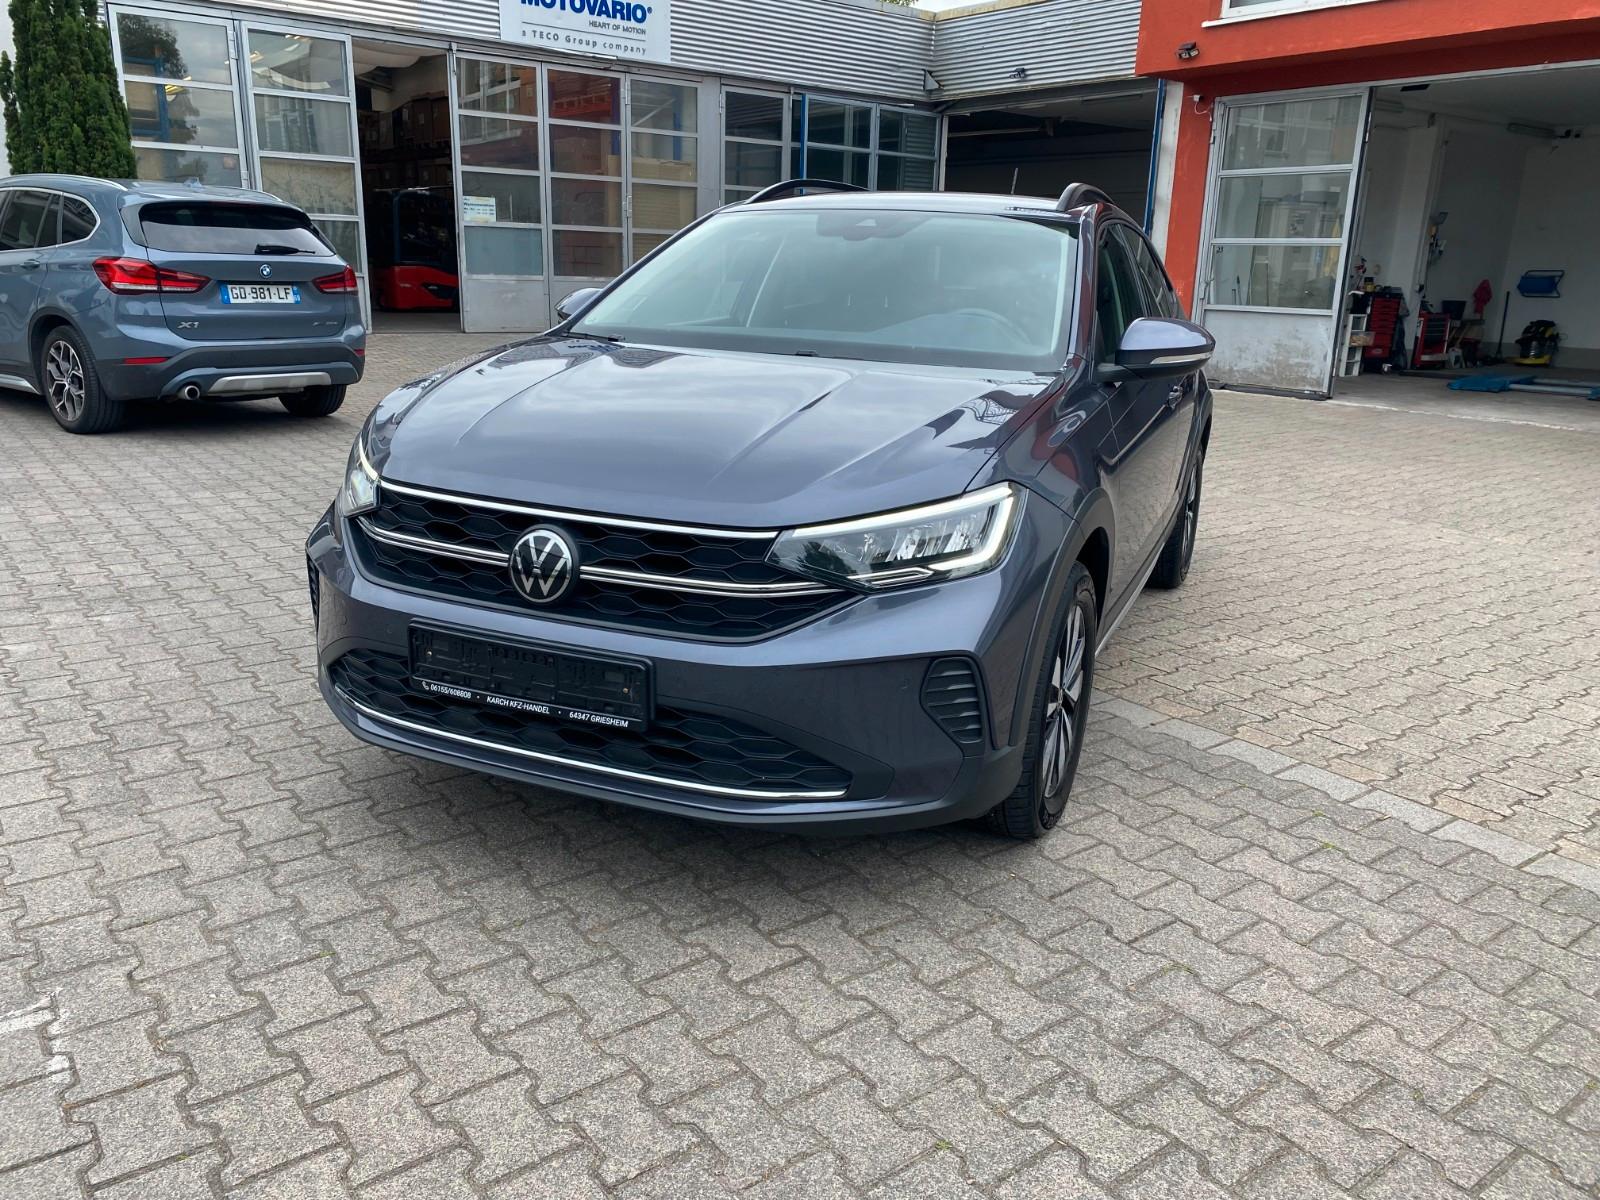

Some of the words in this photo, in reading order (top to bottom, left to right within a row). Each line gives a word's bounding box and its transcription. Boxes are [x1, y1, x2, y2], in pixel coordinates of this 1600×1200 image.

[588, 20, 611, 30] HEART
[622, 26, 646, 35] MOTION
[532, 30, 559, 41] TECO
[565, 35, 597, 48] Group
[603, 41, 647, 54] company
[177, 321, 200, 329] X1
[487, 696, 509, 707] KARCH
[509, 700, 550, 714] KFZ-HANDEL
[569, 711, 590, 721] 64347
[590, 715, 629, 728] GRIESHEIM
